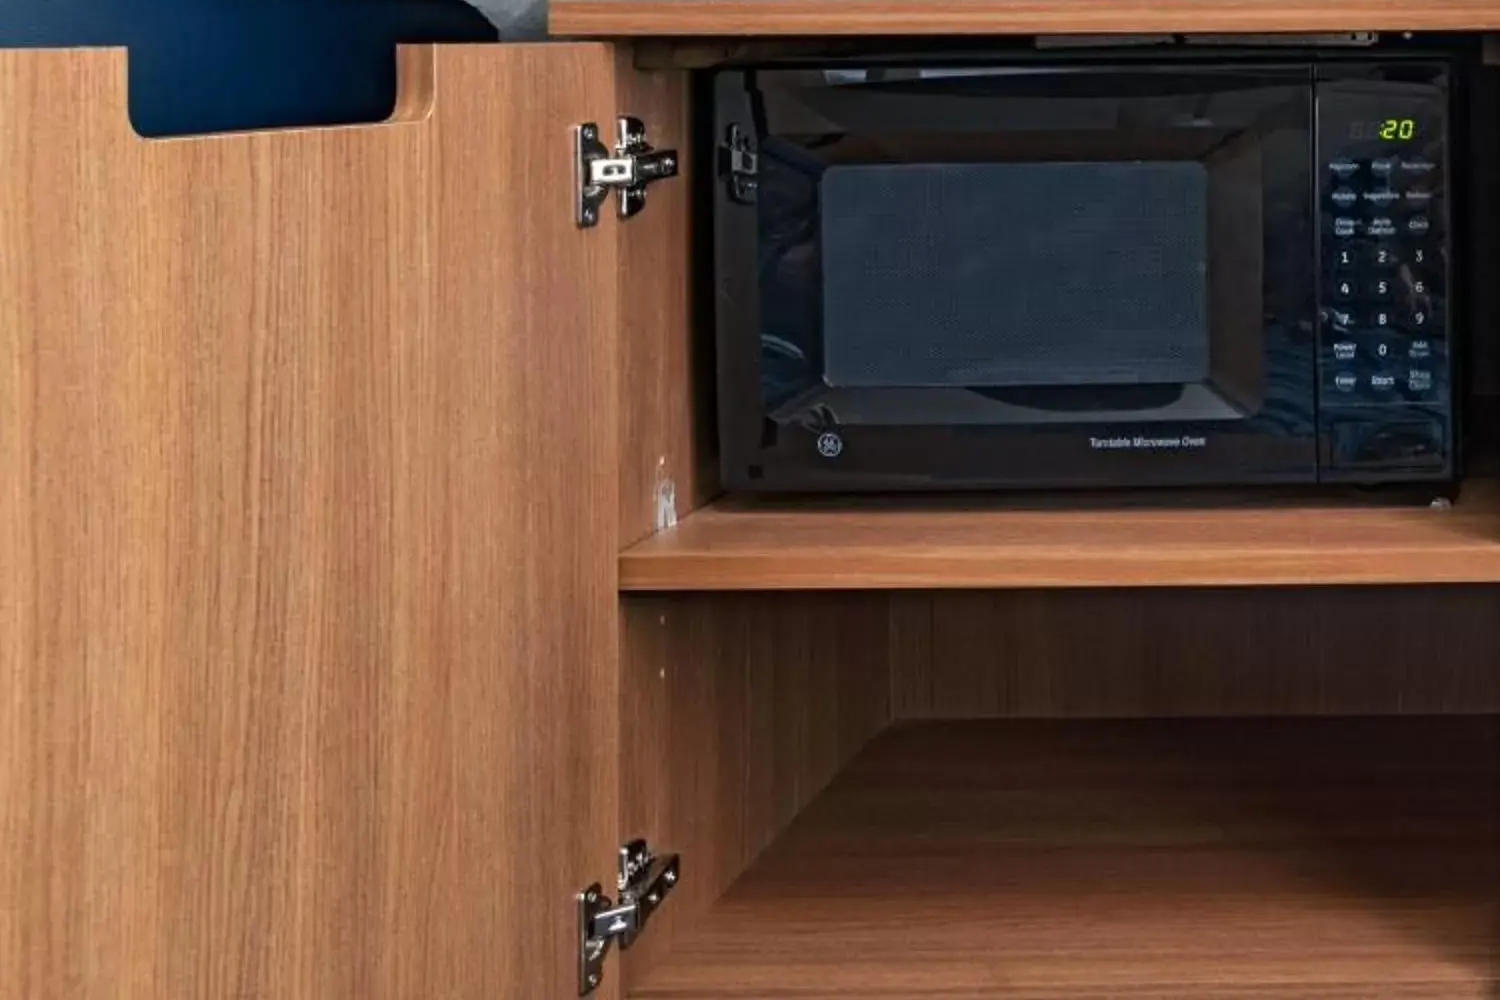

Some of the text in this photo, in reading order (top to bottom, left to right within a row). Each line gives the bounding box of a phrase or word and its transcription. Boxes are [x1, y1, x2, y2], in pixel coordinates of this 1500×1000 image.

[1342, 251, 1349, 263] 1
[1378, 251, 1387, 263] 2
[1415, 250, 1424, 262] 3
[1341, 283, 1350, 294] 4
[1378, 281, 1387, 294] 5
[1415, 281, 1425, 293] 6
[1378, 313, 1387, 325] 8
[1415, 312, 1425, 325] 9
[1378, 343, 1387, 356] 0
